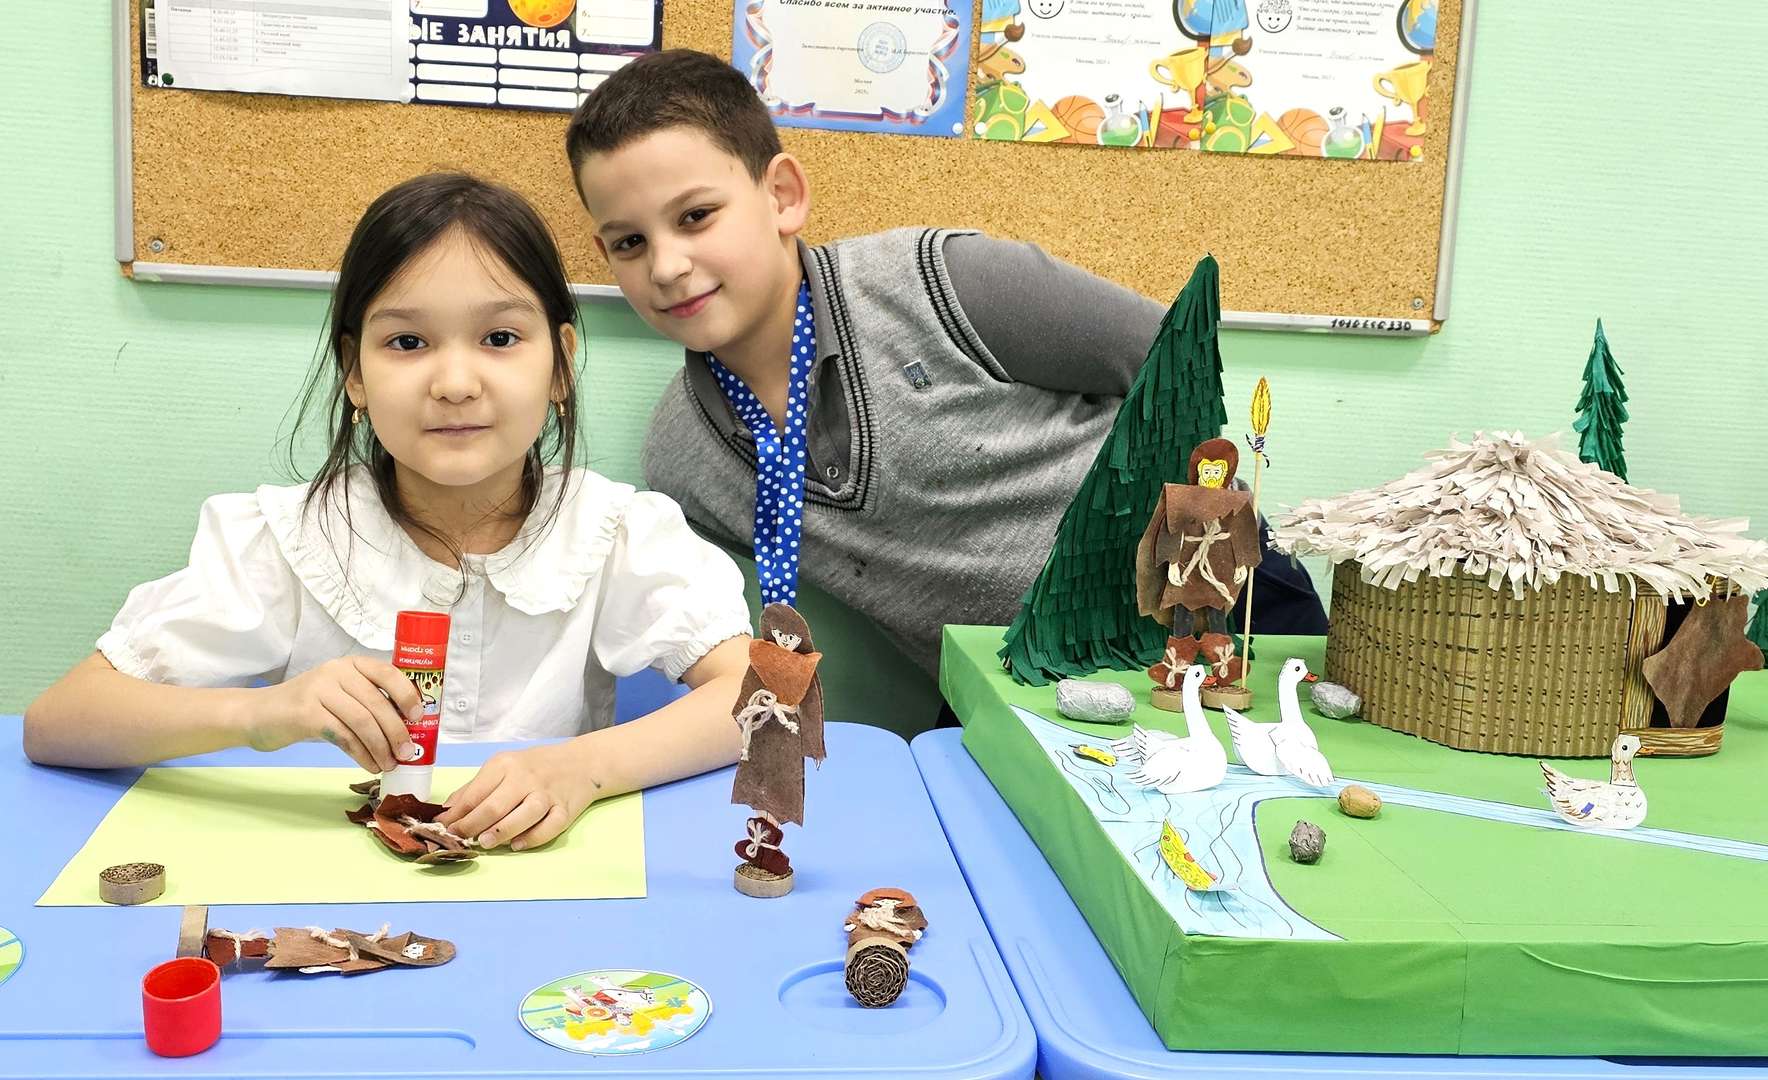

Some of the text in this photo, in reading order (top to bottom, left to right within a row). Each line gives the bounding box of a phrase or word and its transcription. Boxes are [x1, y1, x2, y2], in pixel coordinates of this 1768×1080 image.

[824, 1, 850, 9] всем
[866, 3, 912, 13] активное
[914, 6, 957, 16] участие.
[409, 16, 571, 49] ЫЕ ЗАНЯТИЯ
